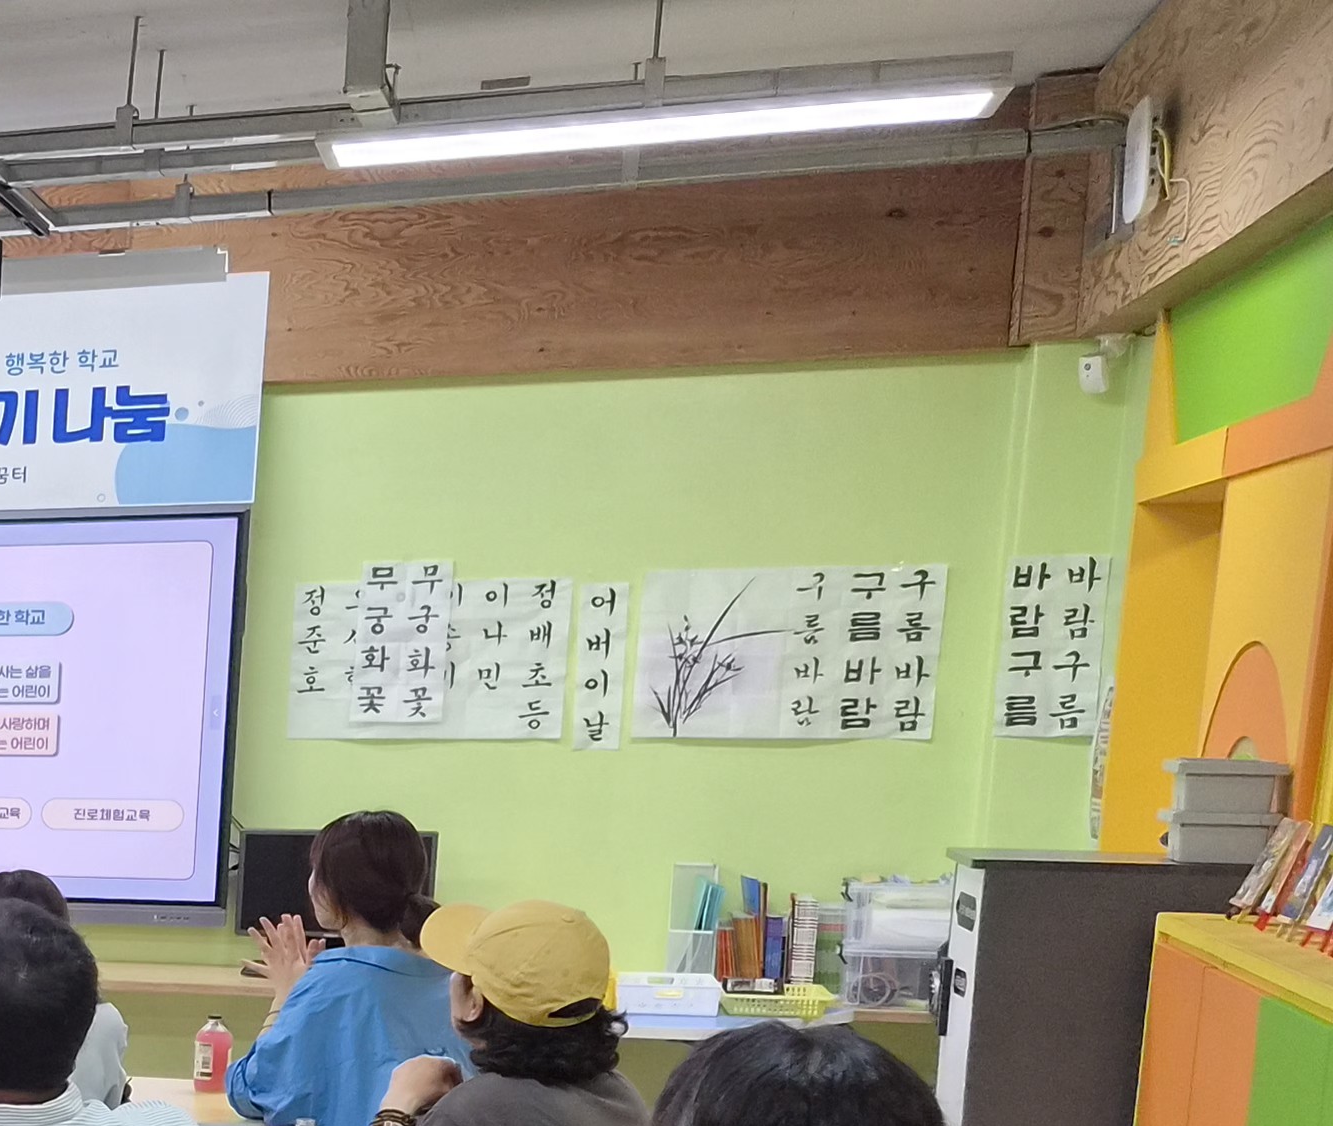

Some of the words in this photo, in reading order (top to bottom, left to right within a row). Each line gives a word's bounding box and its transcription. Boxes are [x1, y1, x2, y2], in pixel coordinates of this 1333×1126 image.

[5, 350, 69, 376] 행복한
[77, 349, 119, 373] 학교
[52, 385, 170, 444] 나눔
[14, 609, 46, 626] 학교
[583, 587, 617, 742] 어버이날
[25, 665, 52, 679] 삶을
[11, 684, 50, 698] 어린이
[0, 717, 50, 731] 사랑하며
[10, 737, 49, 750] 어린이
[73, 808, 151, 822] 진로체험교육
